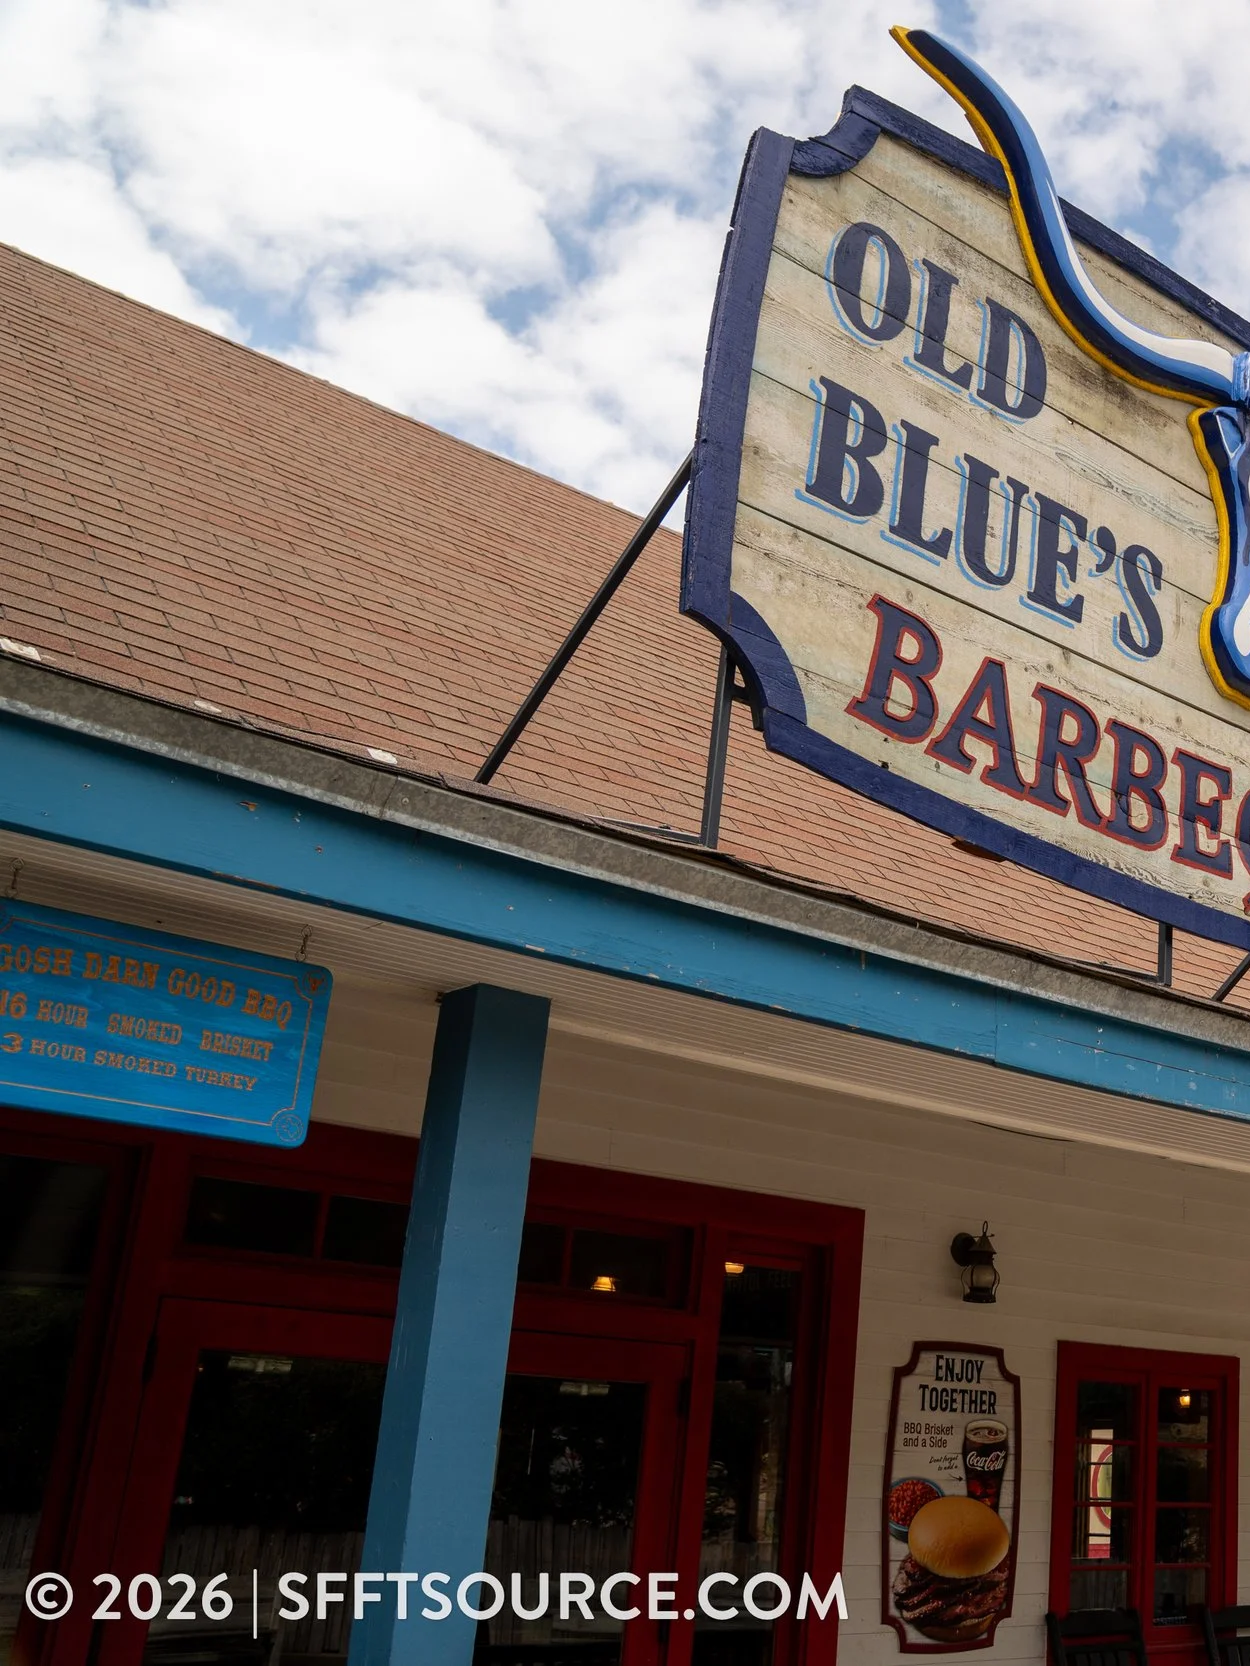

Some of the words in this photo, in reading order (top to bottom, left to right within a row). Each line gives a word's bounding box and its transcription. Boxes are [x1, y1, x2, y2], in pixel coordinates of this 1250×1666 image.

[825, 221, 1047, 425] OLD
[794, 375, 1165, 662] BLUE'S
[0, 943, 73, 977] GOSH
[82, 951, 160, 989] DARN
[167, 967, 236, 1007] GOOD
[241, 987, 293, 1031] BBQ
[35, 1000, 89, 1029] HOUR
[107, 1012, 183, 1045] SMOKED
[199, 1029, 274, 1062] BRISKET
[0, 1032, 24, 1054] 3
[29, 1038, 87, 1062] HOUR
[93, 1049, 177, 1078] SMOKED
[185, 1065, 258, 1092] TURKEY
[918, 1383, 997, 1415] TOGETHER
[935, 1354, 985, 1384] ENJOY
[902, 1436, 919, 1448] and
[921, 1438, 927, 1448] a
[929, 1437, 948, 1449] Side
[903, 1422, 922, 1435] BBQ
[924, 1423, 954, 1436] Brisket
